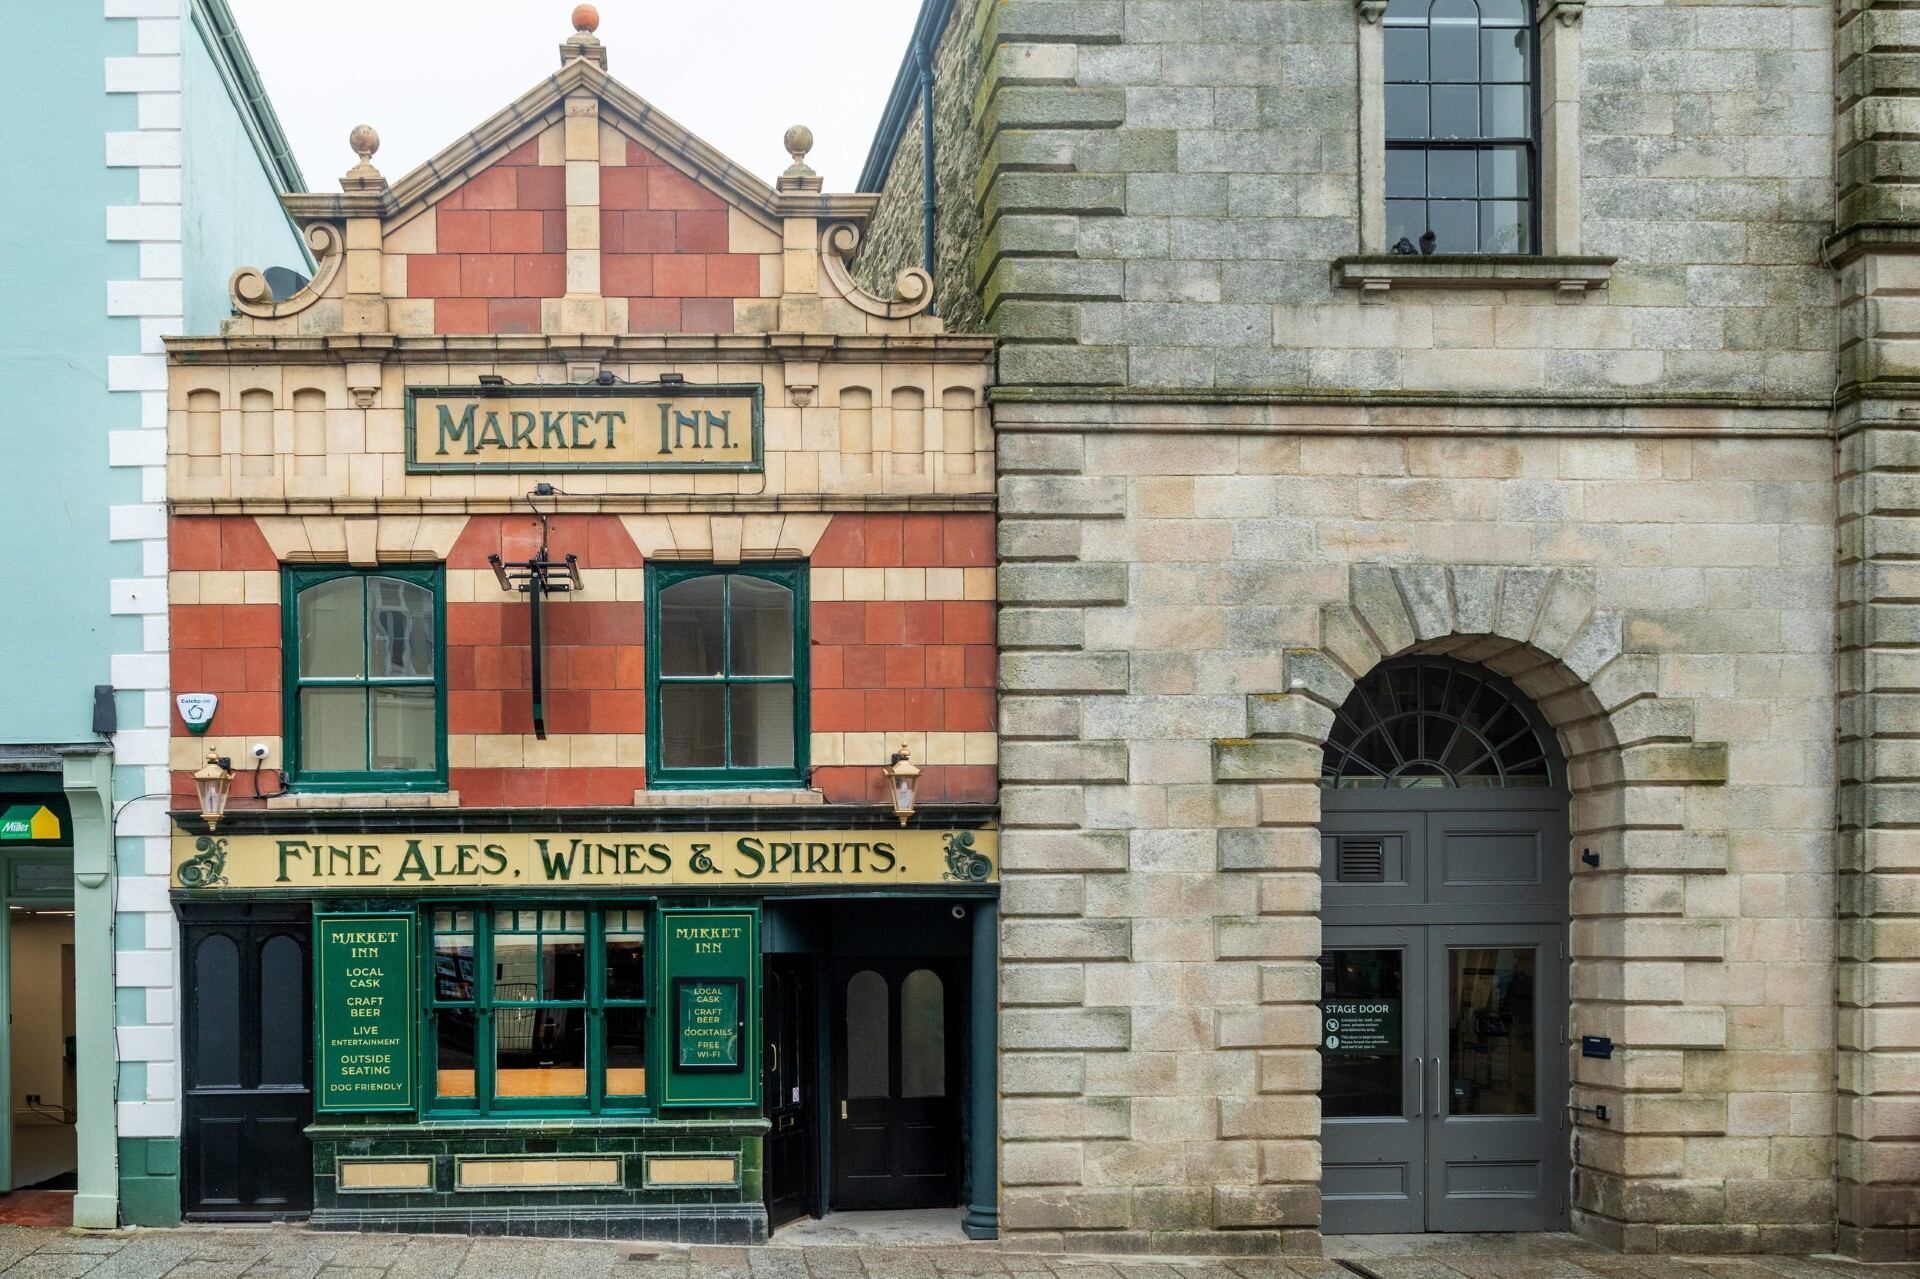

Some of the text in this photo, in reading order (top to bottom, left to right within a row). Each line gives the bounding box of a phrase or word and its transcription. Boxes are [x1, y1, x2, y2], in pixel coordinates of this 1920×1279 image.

[435, 403, 738, 455] MARKET INN.
[1, 821, 29, 832] Miller
[275, 836, 907, 882] FINE ALES, WINES & SPIRITS.
[332, 932, 398, 944] MARKET
[676, 928, 741, 939] MARKET
[696, 942, 722, 952] INN
[352, 948, 379, 957] INN
[346, 968, 384, 976] LOCAL
[1325, 1004, 1389, 1014] STAGE DOOR
[340, 1054, 391, 1063] OUTSIDE
[342, 1066, 390, 1075] SEATING
